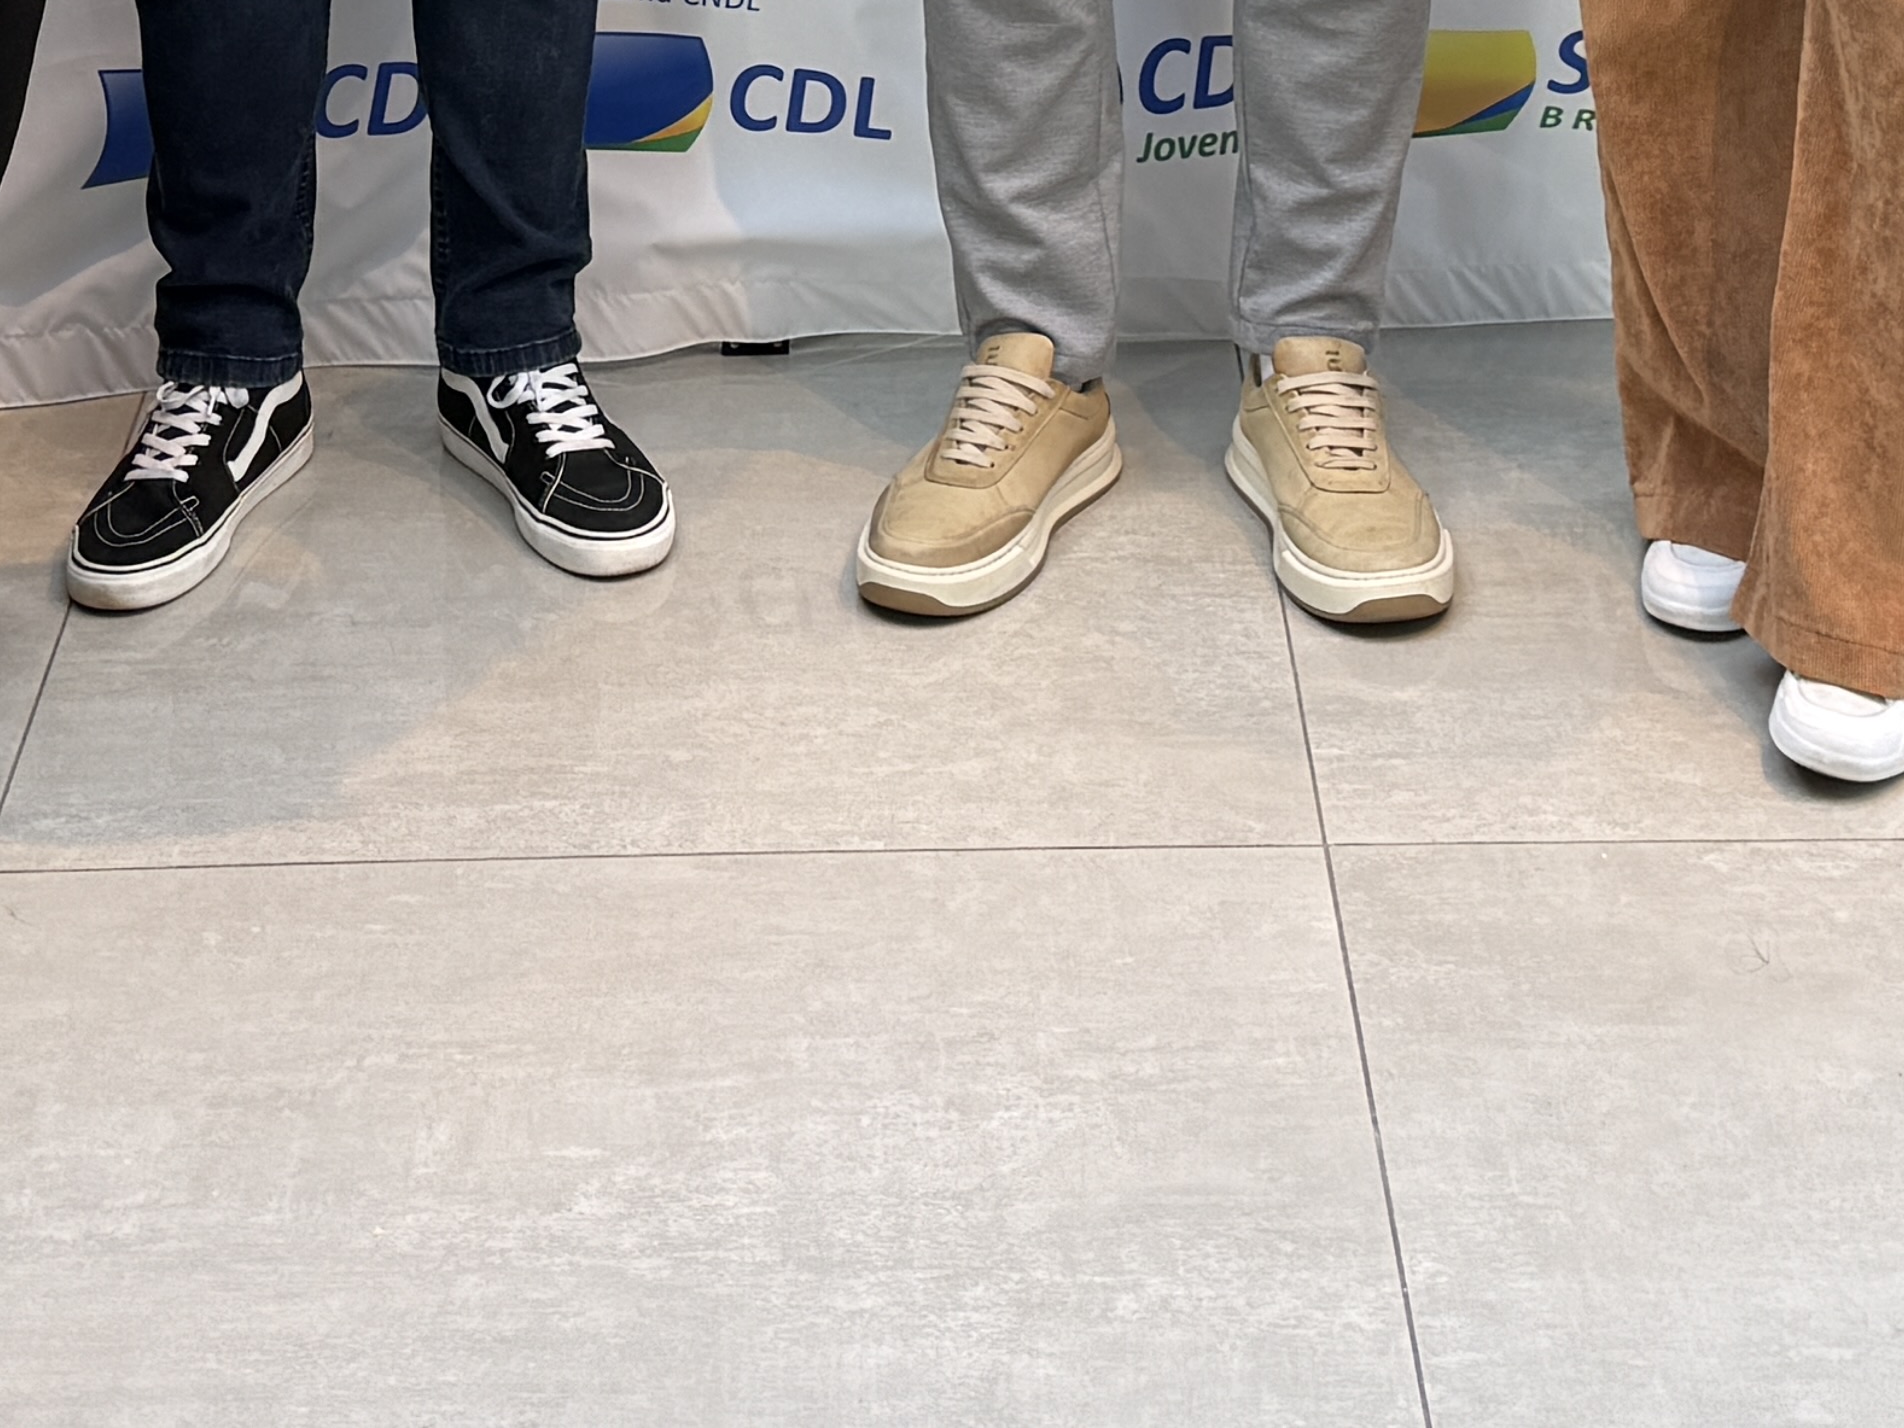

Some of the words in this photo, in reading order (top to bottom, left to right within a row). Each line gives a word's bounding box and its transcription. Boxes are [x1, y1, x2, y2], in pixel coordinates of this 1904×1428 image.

[316, 62, 428, 138] CD
[730, 64, 892, 140] CDL
[1139, 35, 1233, 114] CD
